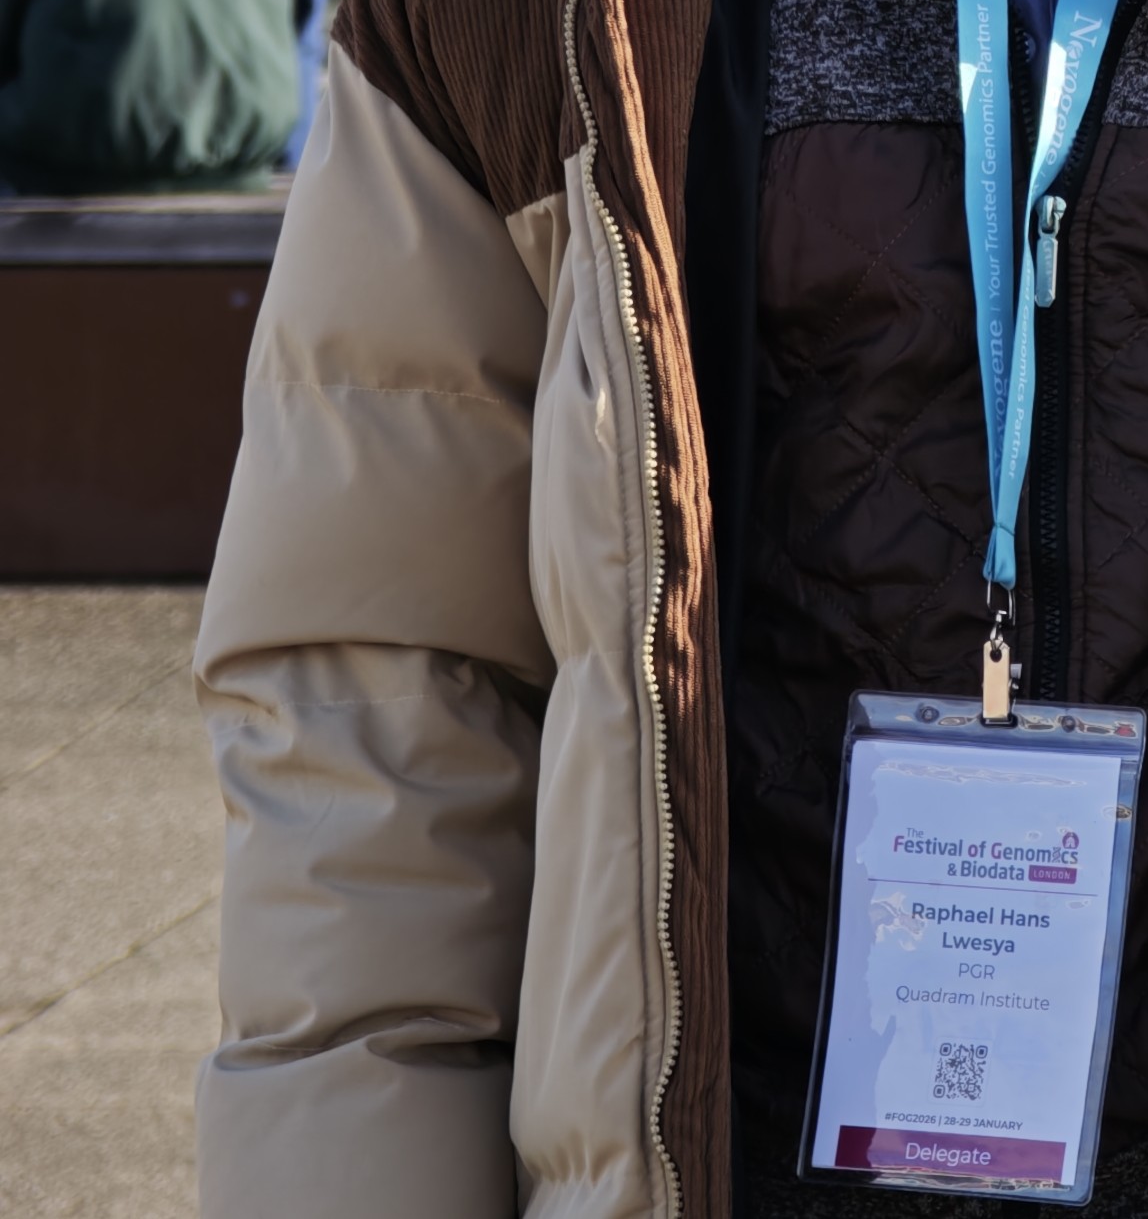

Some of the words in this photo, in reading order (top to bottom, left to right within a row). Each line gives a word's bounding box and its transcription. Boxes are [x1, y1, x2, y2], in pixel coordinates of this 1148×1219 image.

[976, 3, 993, 74] Partner
[979, 78, 997, 175] Genomics
[983, 180, 1000, 254] Trusted
[988, 254, 1001, 301] Your
[1017, 306, 1030, 403] Genomics
[1009, 409, 1025, 479] Partner
[907, 827, 924, 839] The
[893, 835, 963, 857] Festival
[968, 841, 987, 858] of
[991, 842, 1079, 865] Genomics
[947, 863, 957, 877] &
[960, 860, 1025, 881] Biodata
[1033, 869, 1071, 880] LONDON
[911, 902, 994, 925] Raphael
[1000, 909, 1051, 928] Hans
[942, 932, 1015, 956] Lwesya
[958, 962, 995, 980] PGR
[896, 985, 975, 1006] Quadram
[980, 991, 1050, 1011] Institute
[884, 1112, 937, 1125] #FOG2026
[943, 1116, 971, 1127] 28-29
[973, 1119, 1023, 1131] JANUARY
[905, 1142, 992, 1167] Delegate
